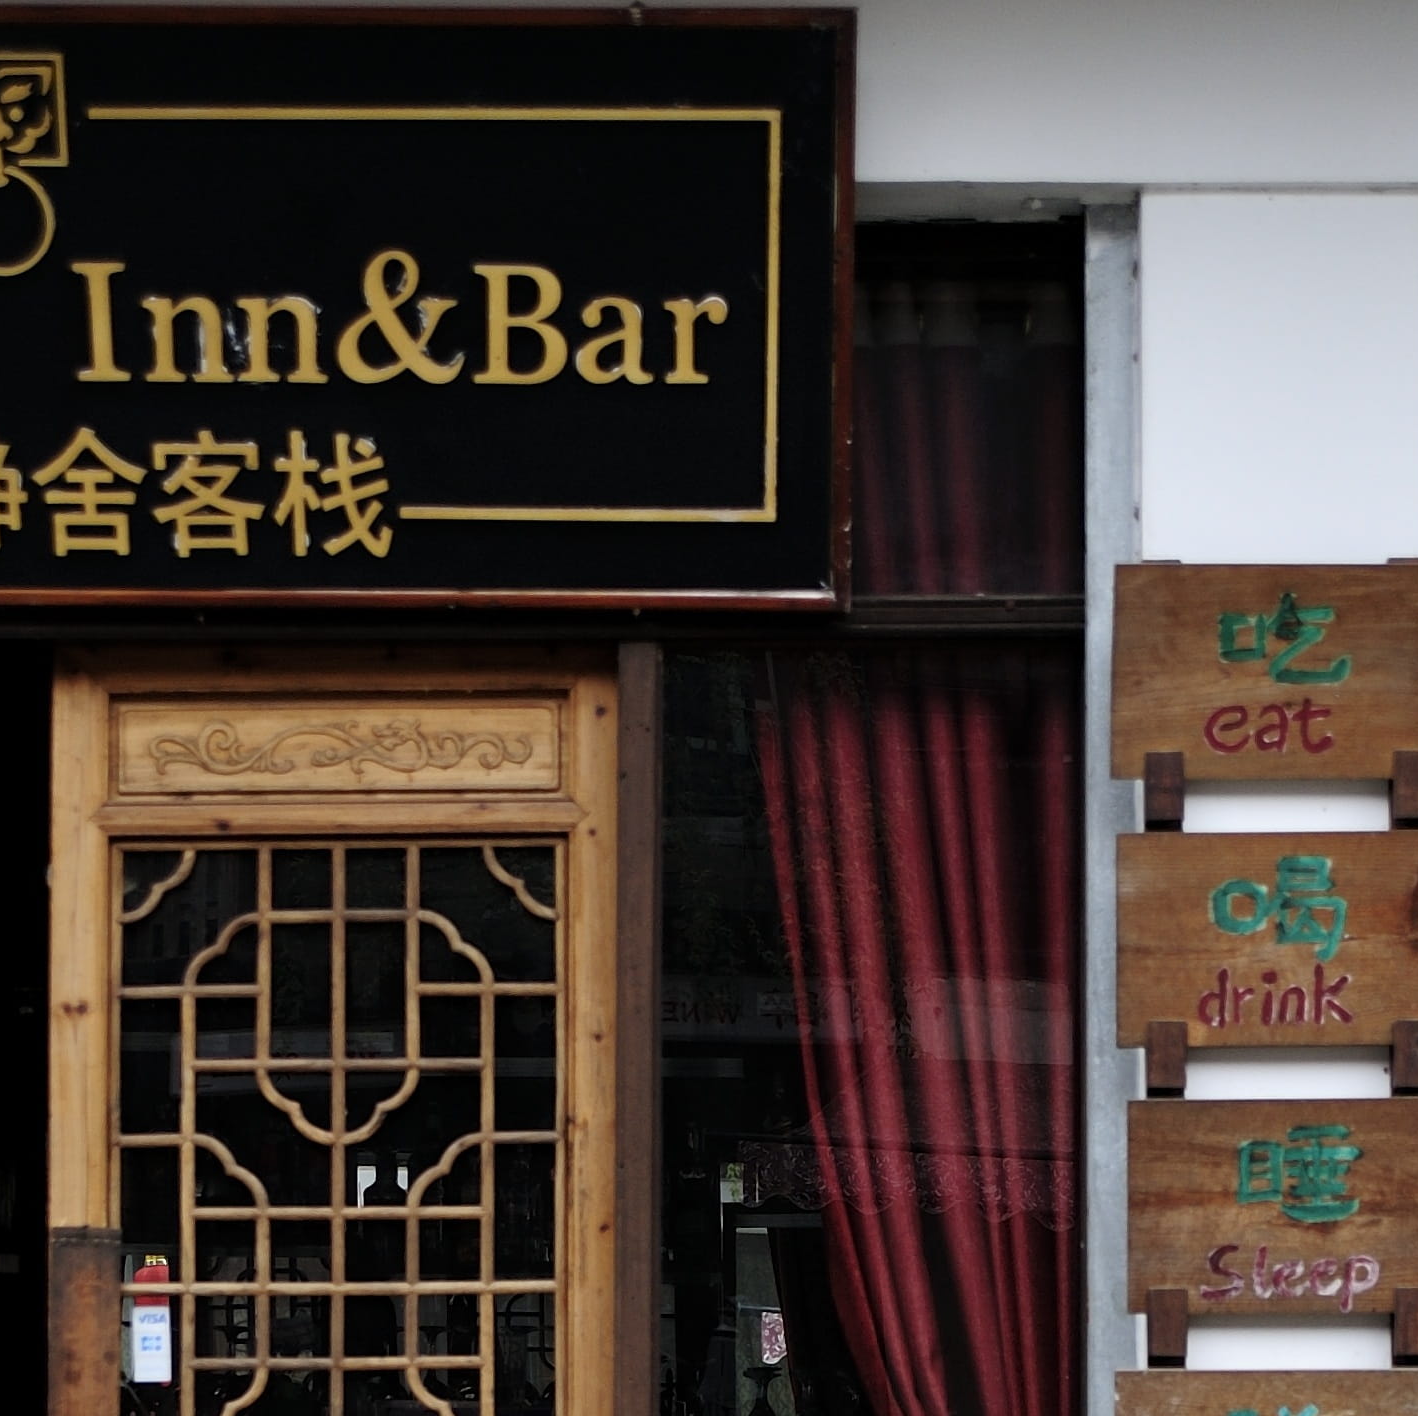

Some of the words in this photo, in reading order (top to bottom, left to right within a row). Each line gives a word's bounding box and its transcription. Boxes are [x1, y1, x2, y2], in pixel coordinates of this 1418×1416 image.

[70, 250, 729, 385] Inn&Bar
[1218, 591, 1351, 685] 吃
[1204, 698, 1334, 754] eat
[1209, 855, 1347, 962] 喝
[1198, 963, 1354, 1028] drink
[1236, 1125, 1365, 1223] 睡
